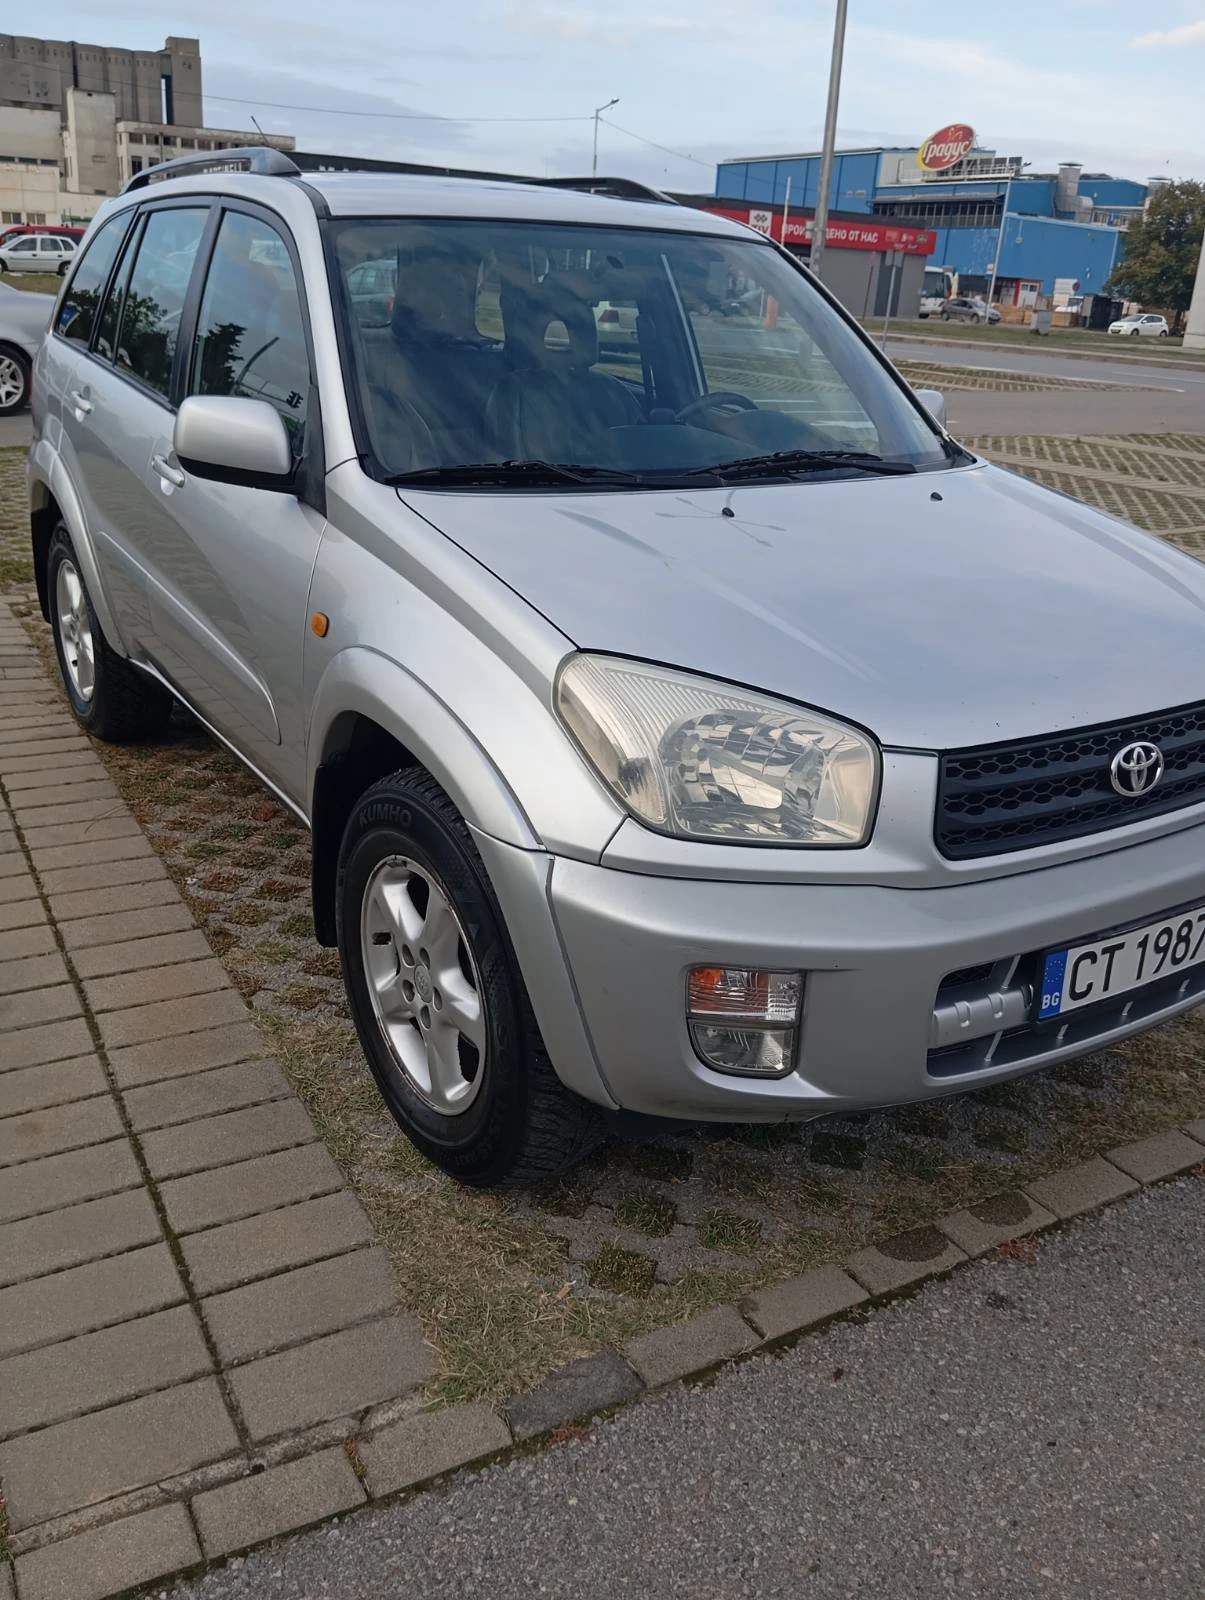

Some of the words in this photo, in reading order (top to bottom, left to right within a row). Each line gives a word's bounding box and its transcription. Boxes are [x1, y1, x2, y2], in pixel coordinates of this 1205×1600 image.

[923, 140, 969, 163] Градус
[848, 230, 859, 241] ОТ
[861, 231, 878, 243] НАС
[359, 803, 412, 828] KUMHO
[1069, 942, 1127, 1001] CT
[1136, 912, 1205, 981] 1987
[1041, 992, 1060, 1010] BG
